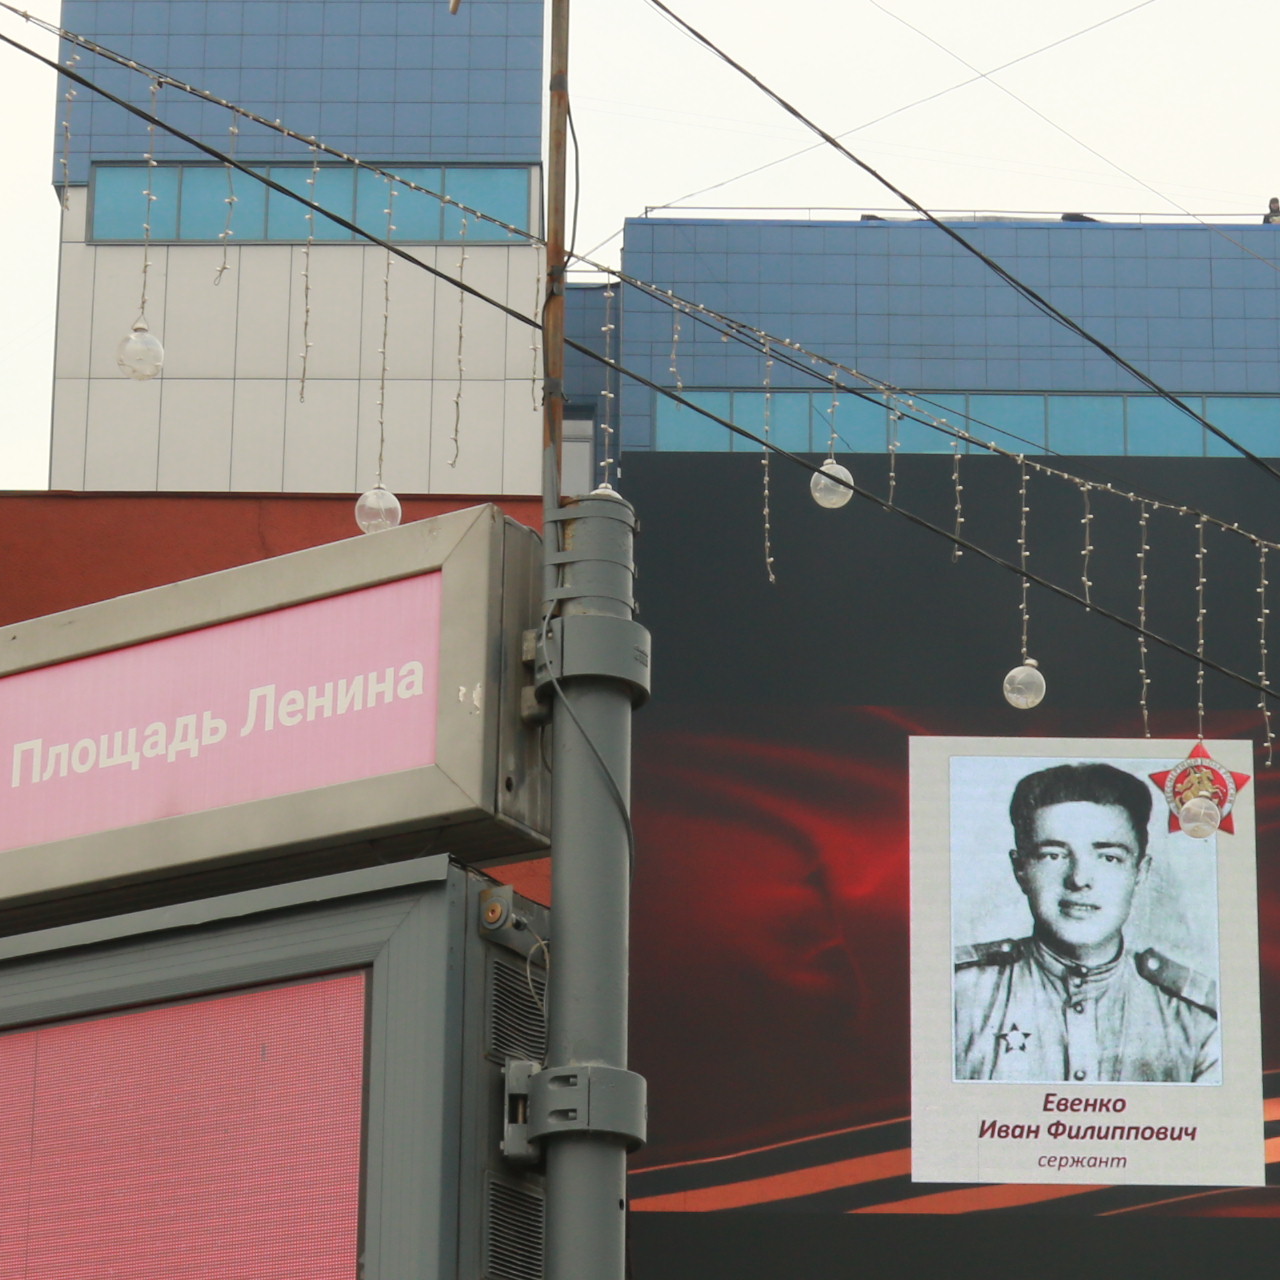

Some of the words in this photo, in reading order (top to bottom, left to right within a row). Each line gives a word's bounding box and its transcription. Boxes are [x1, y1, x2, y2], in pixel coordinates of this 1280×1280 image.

[11, 711, 228, 788] Площадь
[240, 660, 424, 738] Ленина
[1042, 1092, 1127, 1114] Евенко
[978, 1119, 1040, 1141] Иван
[1046, 1119, 1198, 1142] Филиппович
[1037, 1153, 1128, 1170] сержант
